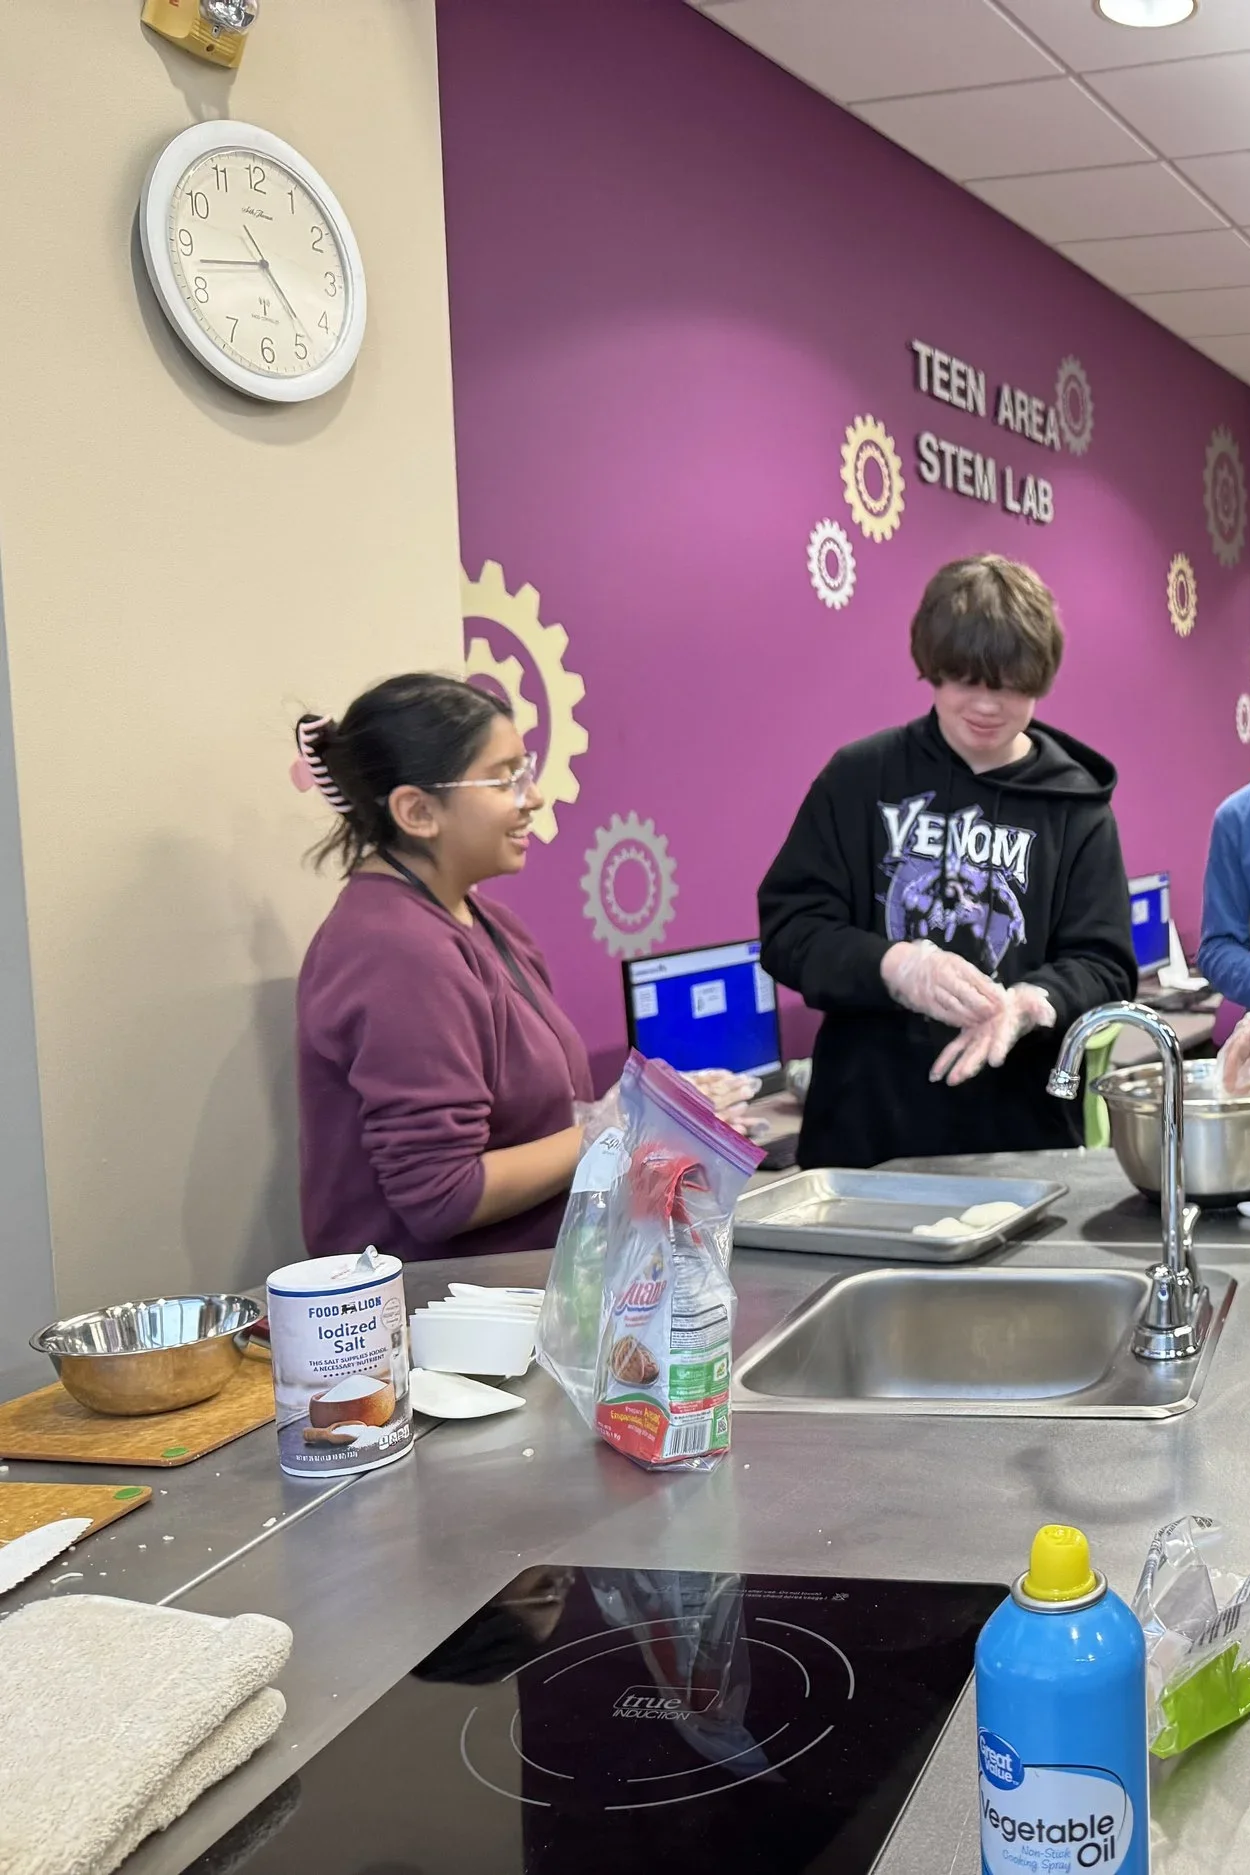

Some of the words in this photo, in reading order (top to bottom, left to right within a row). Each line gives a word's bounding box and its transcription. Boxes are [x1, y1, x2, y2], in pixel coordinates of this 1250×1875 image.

[212, 164, 228, 192] 11
[244, 164, 266, 194] 12
[186, 190, 209, 219] 10
[287, 190, 295, 214] 1
[179, 229, 193, 256] 9
[311, 226, 324, 253] 2
[194, 277, 208, 303] 8
[324, 271, 336, 297] 3
[226, 316, 238, 343] 7
[318, 311, 329, 334] 4
[261, 337, 275, 363] 6
[295, 334, 307, 360] 5
[911, 338, 986, 418] TEEN
[997, 383, 1061, 451] AREA
[918, 432, 998, 503] STEM
[1004, 465, 1054, 523] LAB
[879, 794, 1035, 889] VENOM
[308, 1305, 339, 1318] FOOD
[358, 1296, 382, 1311] LION
[318, 1316, 377, 1339] Iodized
[334, 1336, 365, 1353] Salt
[320, 1362, 355, 1372] NECESSARY
[356, 1354, 385, 1366] NUTRIENT
[340, 1353, 368, 1363] SUPPLIES
[612, 1709, 691, 1720] INDUCTION
[622, 1694, 682, 1709] true
[980, 1735, 1013, 1773] Great
[984, 1757, 1014, 1783] Value
[980, 1790, 1115, 1843] Vegetable
[1002, 1848, 1038, 1873] Cooking
[1041, 1859, 1072, 1874] Spray
[1021, 1845, 1072, 1859] Non-Stick
[1077, 1835, 1116, 1868] Oil
